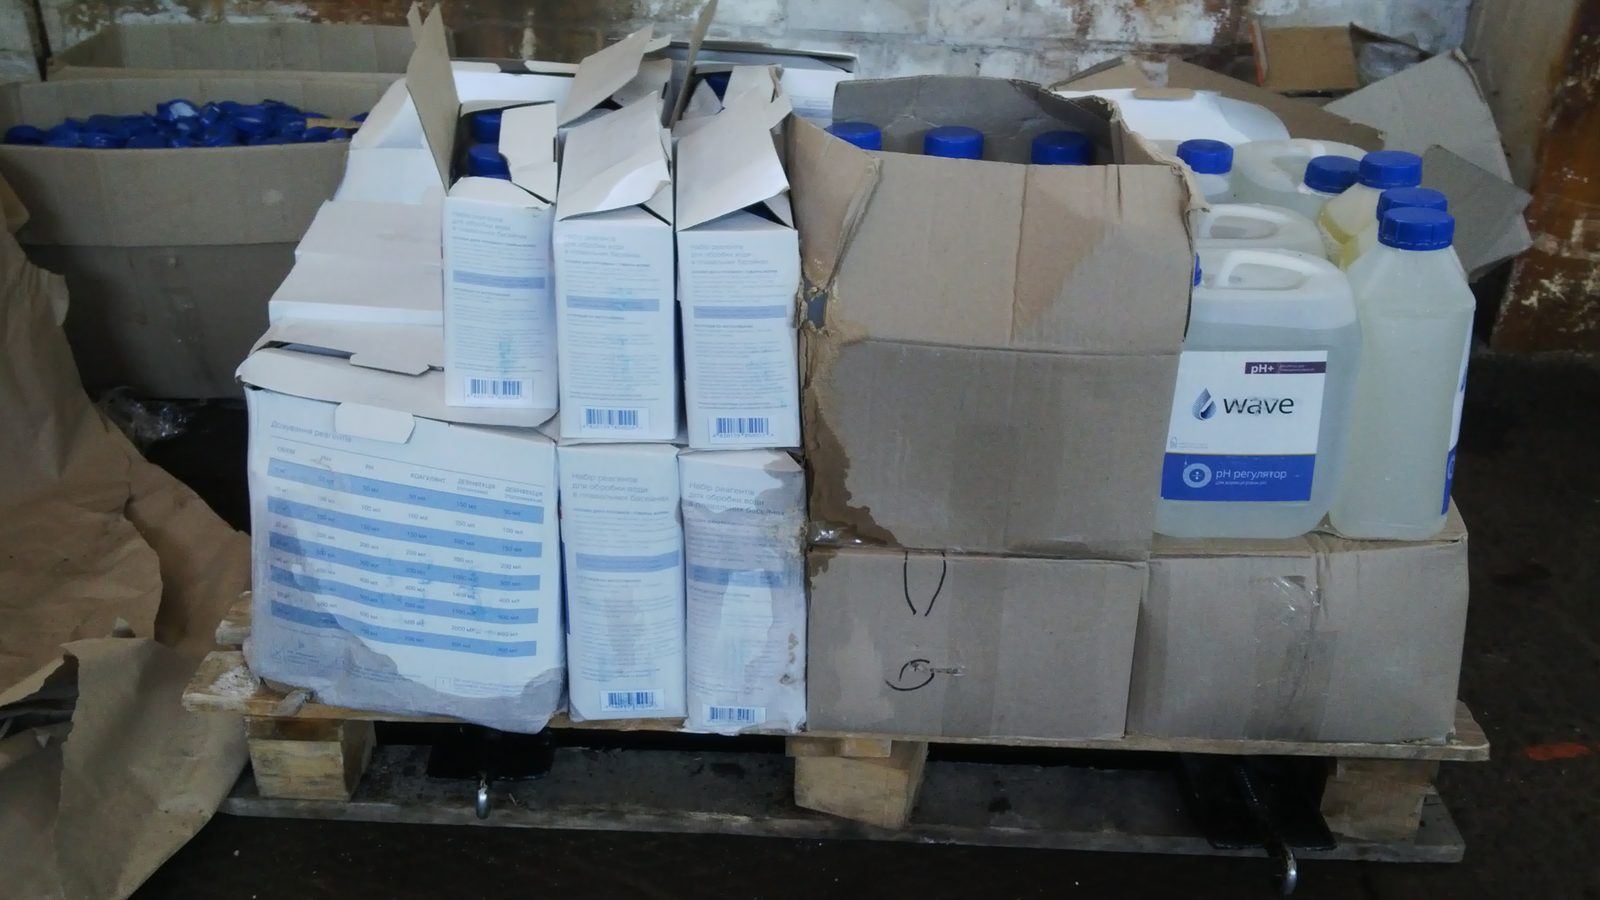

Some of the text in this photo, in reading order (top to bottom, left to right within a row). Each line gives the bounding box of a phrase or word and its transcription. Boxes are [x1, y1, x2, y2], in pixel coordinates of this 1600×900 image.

[1250, 364, 1275, 375] pH+
[1223, 397, 1295, 415] wave
[1215, 469, 1288, 481] pH регулятор
